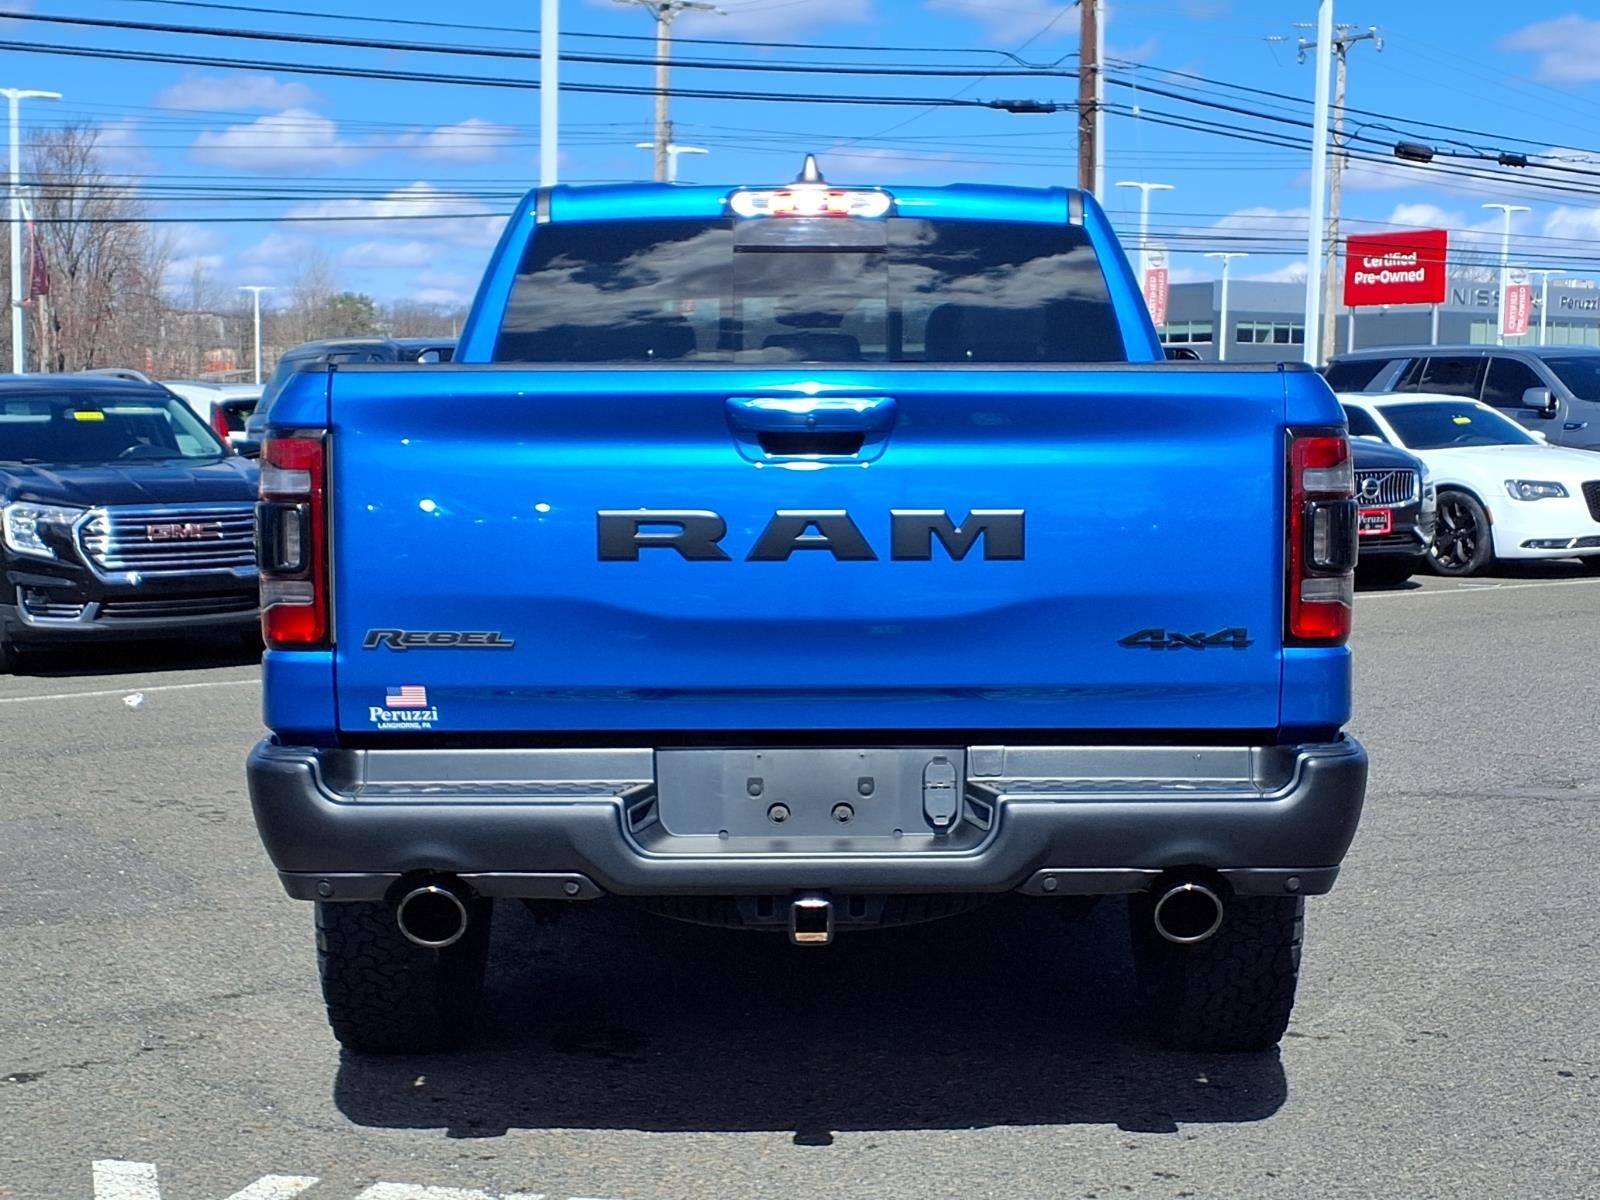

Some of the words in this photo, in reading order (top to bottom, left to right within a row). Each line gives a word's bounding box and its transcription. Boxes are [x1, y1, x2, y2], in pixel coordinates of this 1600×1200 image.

[1363, 251, 1417, 268] Certified
[1354, 267, 1425, 285] Pre-Owned
[147, 522, 223, 541] GMC
[596, 508, 1026, 562] RAM
[363, 628, 515, 649] REBEL
[368, 705, 439, 722] Peruzzi
